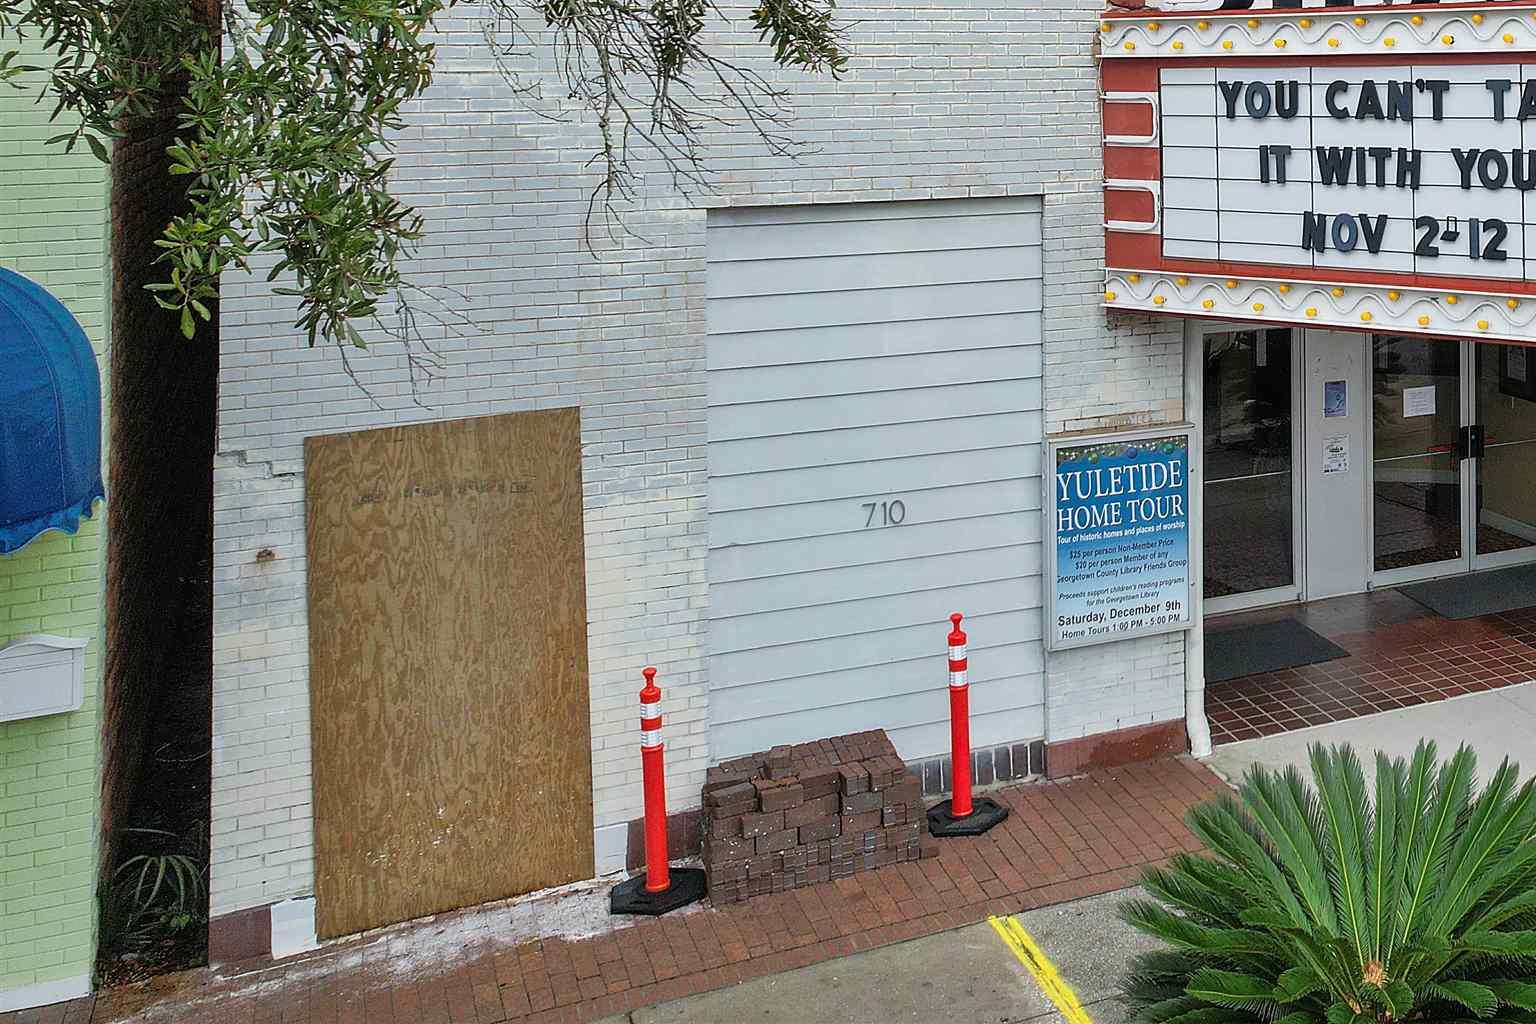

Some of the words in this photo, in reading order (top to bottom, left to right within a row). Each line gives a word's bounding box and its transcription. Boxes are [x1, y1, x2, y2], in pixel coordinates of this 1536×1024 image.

[1218, 80, 1300, 119] YOU
[1325, 78, 1450, 122] CAN'T
[1258, 144, 1292, 184] IT
[1316, 146, 1422, 190] WITH
[1302, 210, 1388, 254] NOV
[1414, 215, 1508, 261] 2-12
[1056, 460, 1183, 502] YULETIDE
[862, 499, 906, 528] 710
[1057, 502, 1122, 532] HOME
[1126, 494, 1185, 523] TOUR
[1057, 536, 1071, 545] Tour
[1072, 534, 1079, 543] of
[1080, 532, 1102, 542] historic
[1103, 529, 1122, 539] homes
[1124, 527, 1135, 536] and
[1136, 525, 1155, 536] places
[1156, 523, 1162, 532] of
[1163, 522, 1185, 533] worship
[1081, 549, 1093, 560] per
[1095, 546, 1117, 558] person
[1158, 538, 1174, 547] Price
[1088, 559, 1098, 570] per
[1100, 556, 1122, 568] person
[1124, 552, 1148, 563] Member
[1149, 551, 1156, 560] of
[1096, 568, 1119, 578] County
[1120, 564, 1142, 575] Library
[1143, 561, 1166, 571] Friends
[1167, 559, 1187, 569] Group
[1140, 590, 1160, 599] Library
[1057, 611, 1106, 627] Saturday,
[1109, 603, 1160, 619] December
[1165, 599, 1181, 612] 9th
[1061, 629, 1085, 640] Home
[1088, 624, 1110, 636] Tours
[1130, 619, 1143, 629] PM
[1168, 614, 1181, 624] PM
